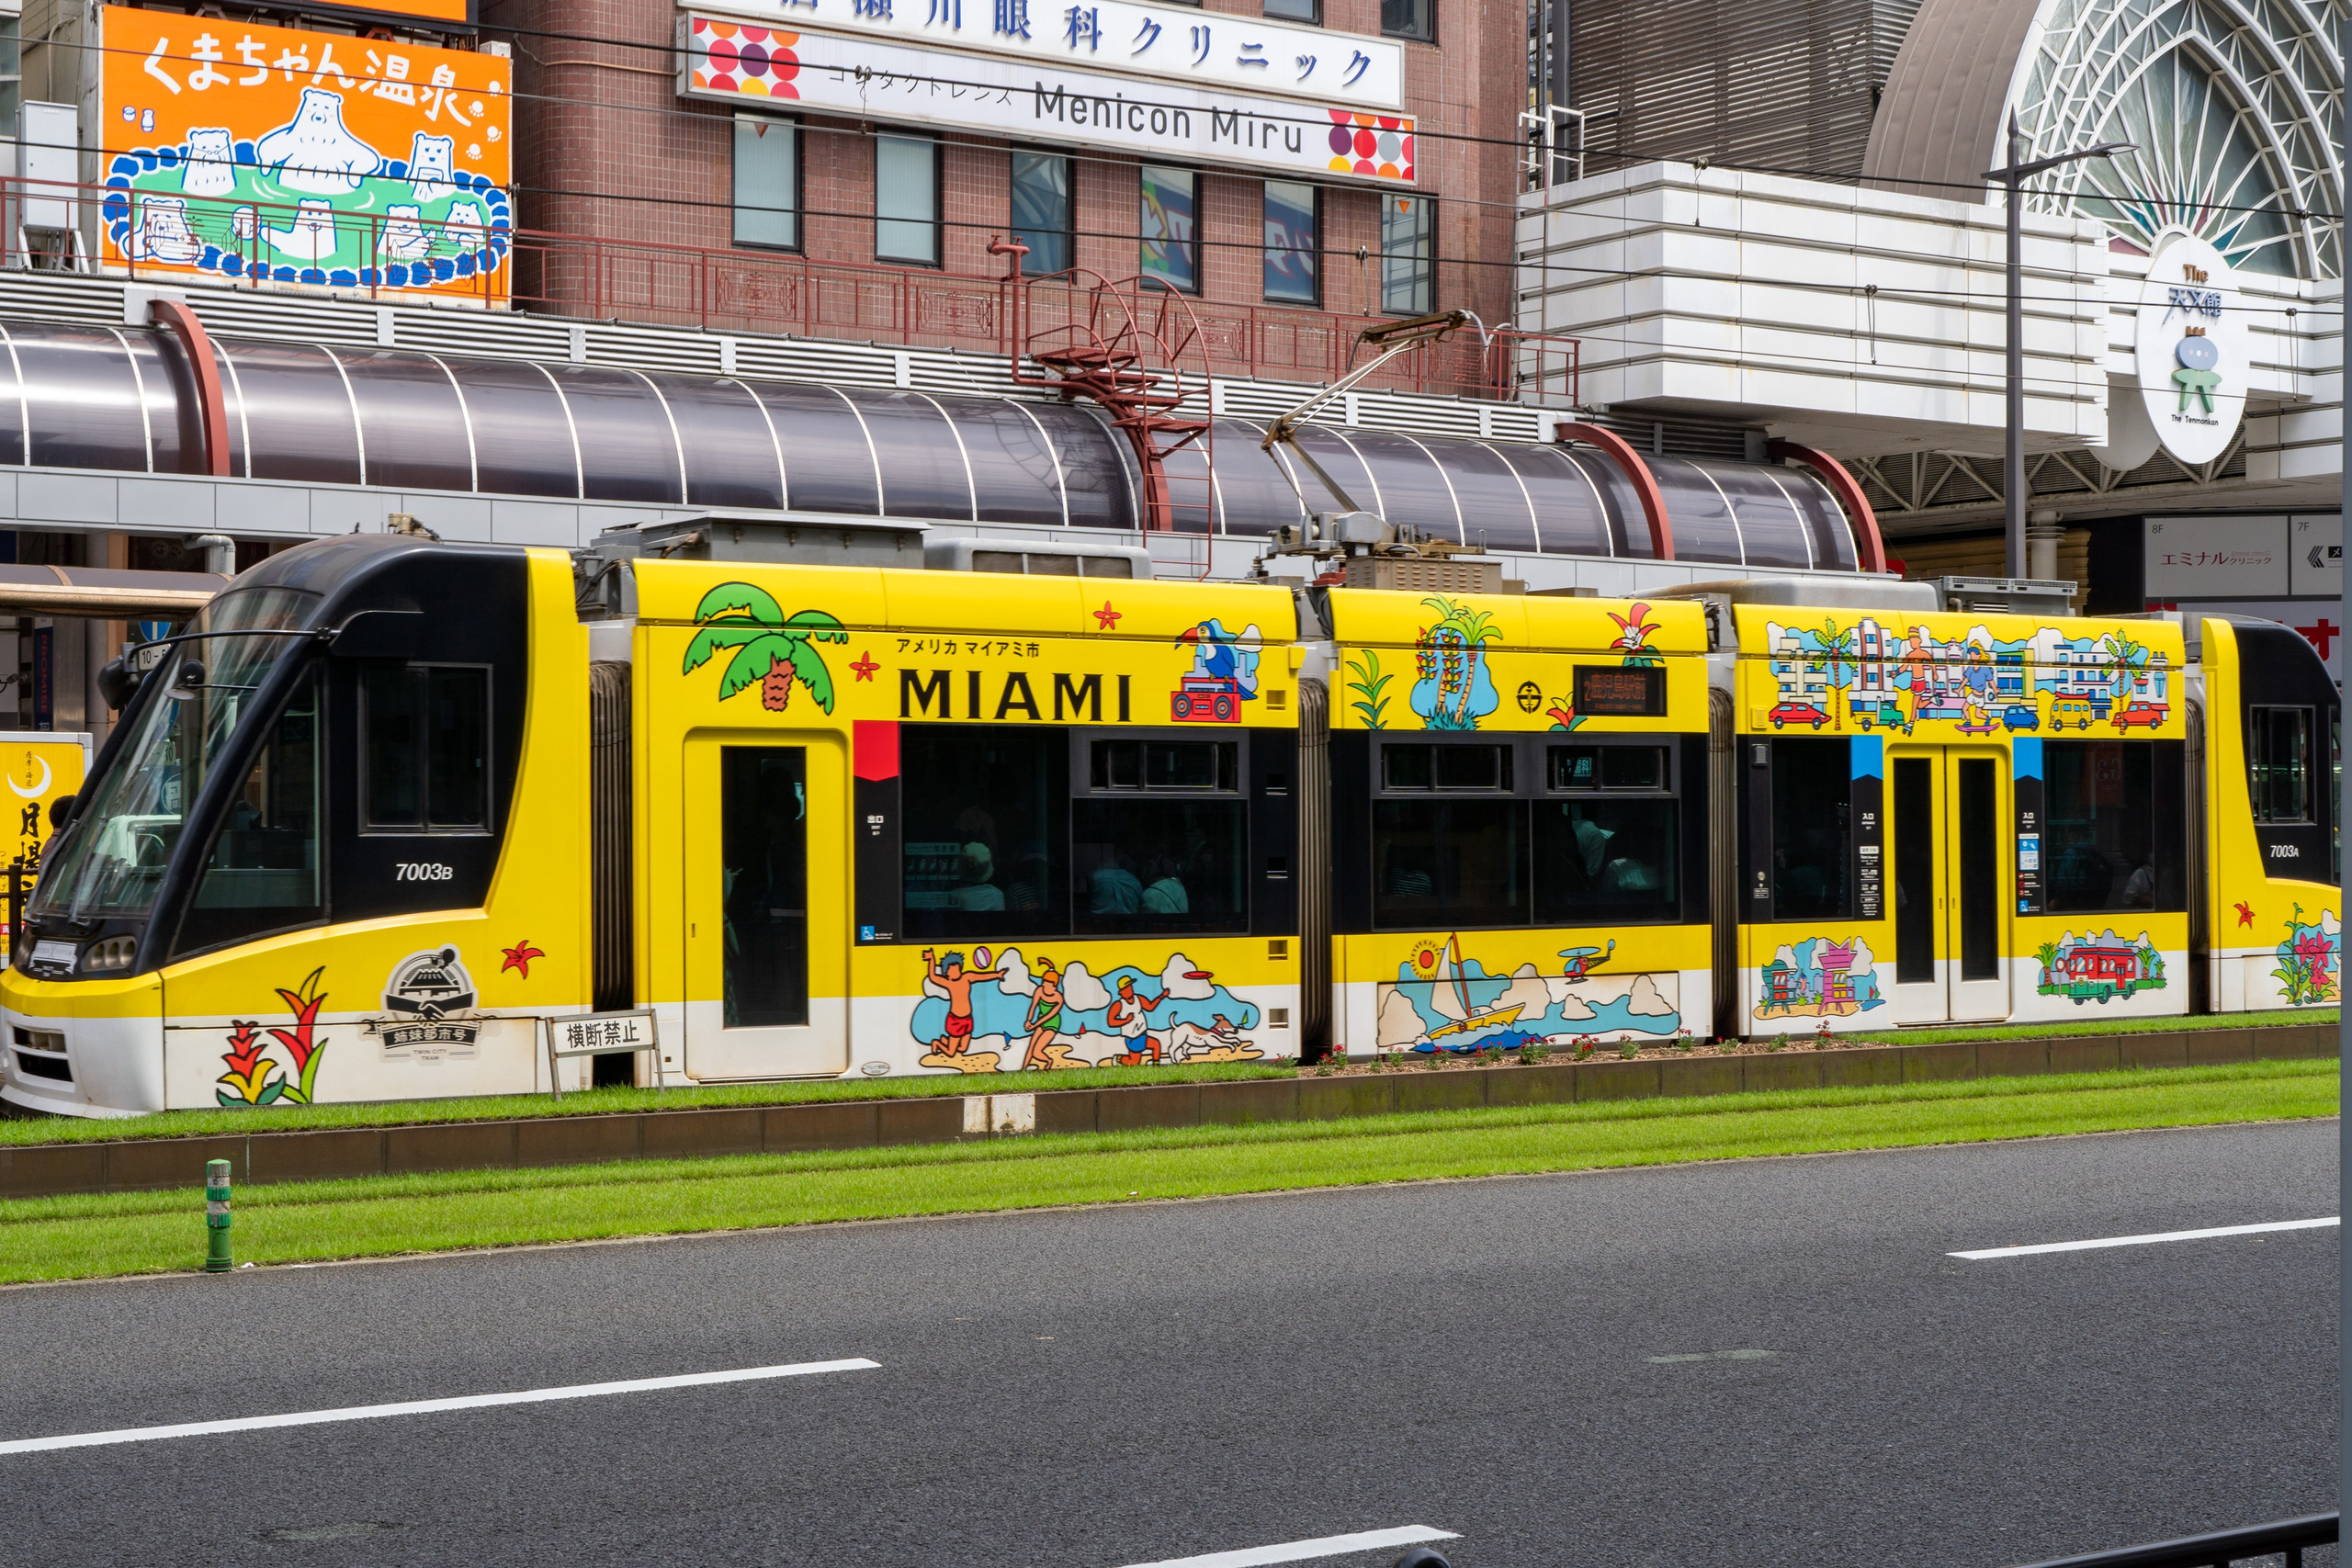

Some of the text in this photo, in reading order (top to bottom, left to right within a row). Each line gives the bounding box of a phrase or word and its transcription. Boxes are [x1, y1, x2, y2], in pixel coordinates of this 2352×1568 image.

[781, 0, 1372, 87] 川眼科クリニック
[144, 33, 472, 128] くまちゃん温泉
[1035, 81, 1303, 153] Menicon Miru
[2183, 264, 2209, 283] The
[2162, 288, 2222, 323] 天文館
[2171, 414, 2220, 426] The Tenmonkan
[2152, 525, 2164, 534] 8F
[2297, 522, 2309, 532] 7F
[897, 638, 1040, 658] アメリカ マイアミ市
[40, 634, 49, 714] PROMISE
[898, 668, 1132, 722] MIAMI
[2270, 845, 2300, 858] 7003A
[395, 863, 454, 881] 7003B
[393, 1028, 467, 1043] 姉妹都市号
[567, 1020, 640, 1049] 横断禁止
